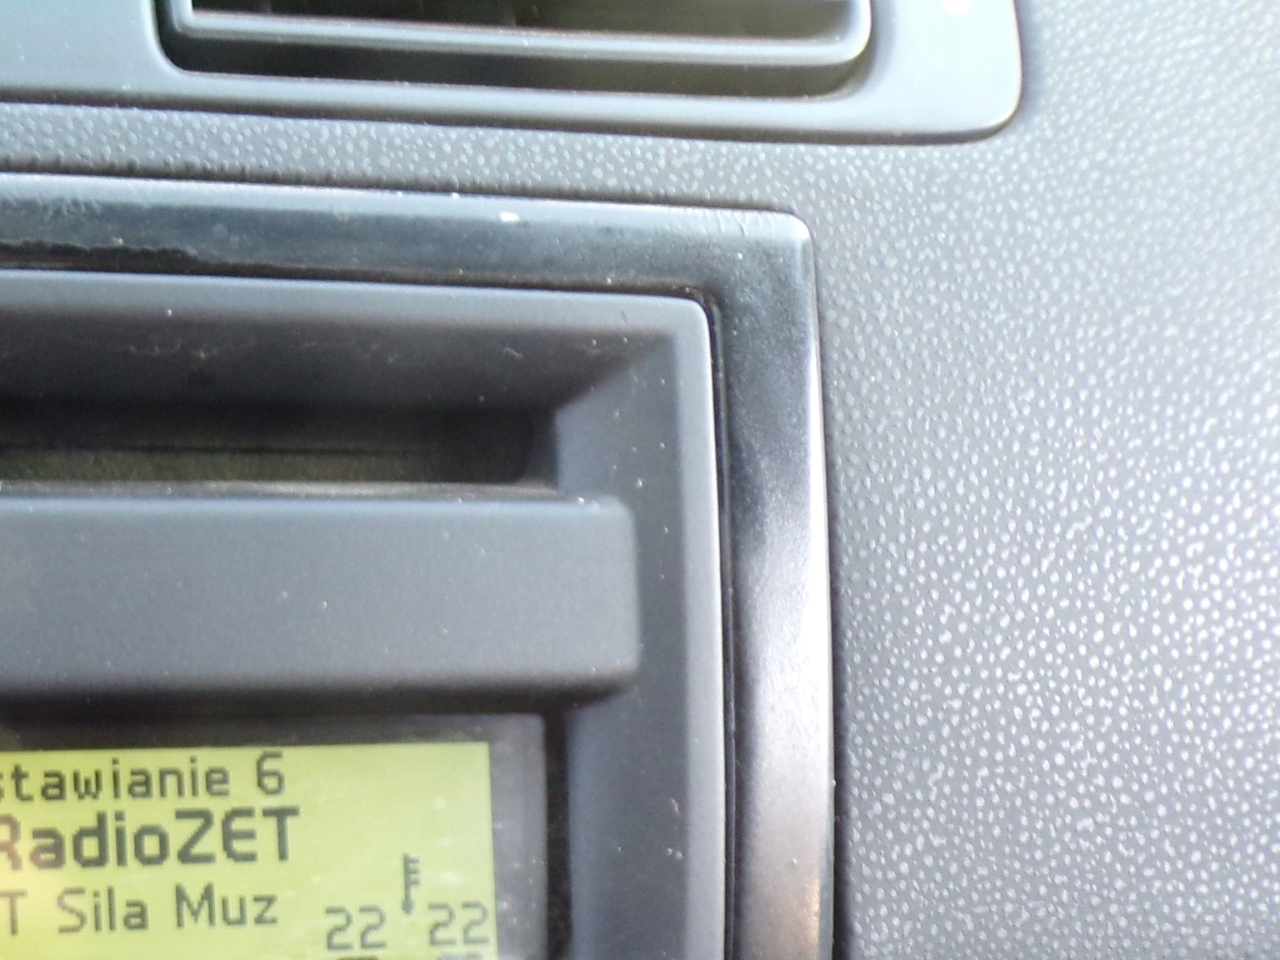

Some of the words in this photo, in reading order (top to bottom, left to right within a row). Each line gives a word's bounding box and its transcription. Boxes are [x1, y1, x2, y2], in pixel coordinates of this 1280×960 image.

[255, 750, 286, 798] 6
[57, 886, 149, 935] Sila
[175, 882, 279, 929] Muz
[326, 904, 387, 951] 22
[428, 901, 489, 948] 22
